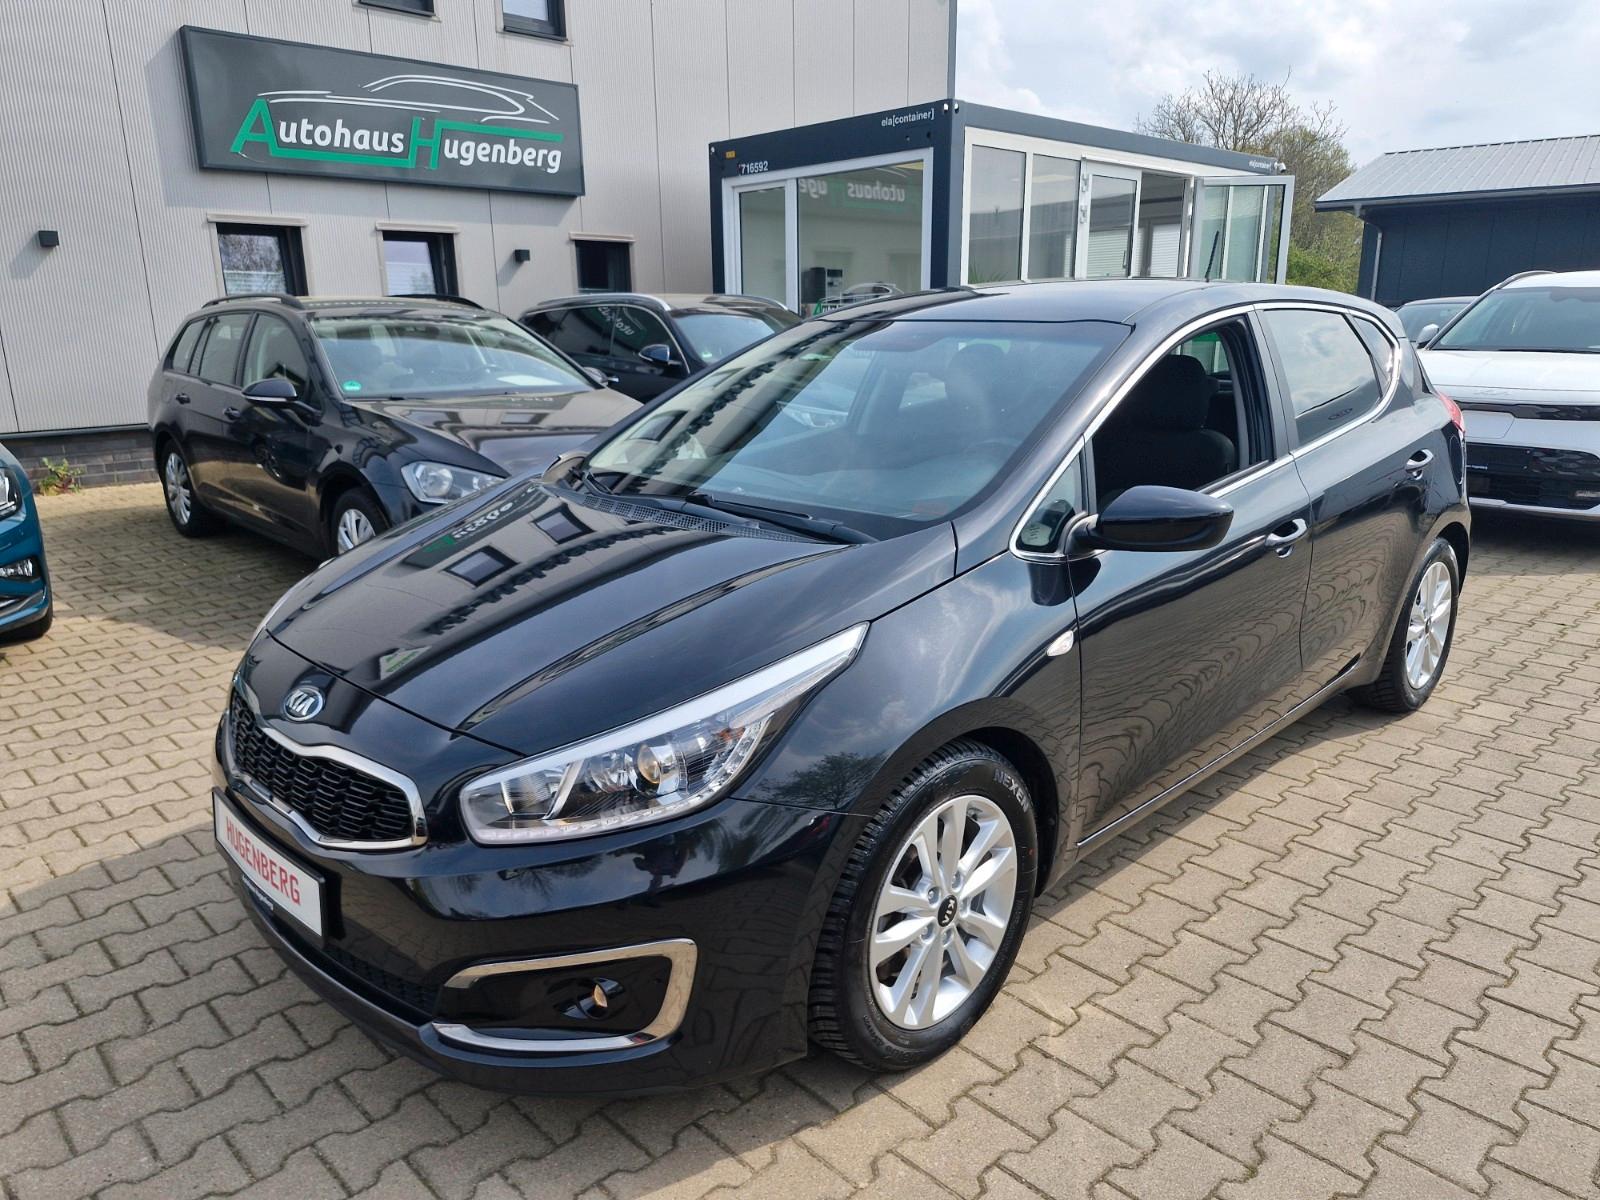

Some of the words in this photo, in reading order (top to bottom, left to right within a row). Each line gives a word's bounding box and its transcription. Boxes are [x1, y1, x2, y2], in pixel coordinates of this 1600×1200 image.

[881, 108, 935, 127] ela[container]
[230, 98, 404, 157] Autohaus
[408, 117, 563, 174] Hugenberg
[739, 160, 769, 174] 716592
[994, 769, 1029, 813] NEXEN
[226, 815, 301, 906] HUGENBERG
[942, 899, 955, 924] KIA
